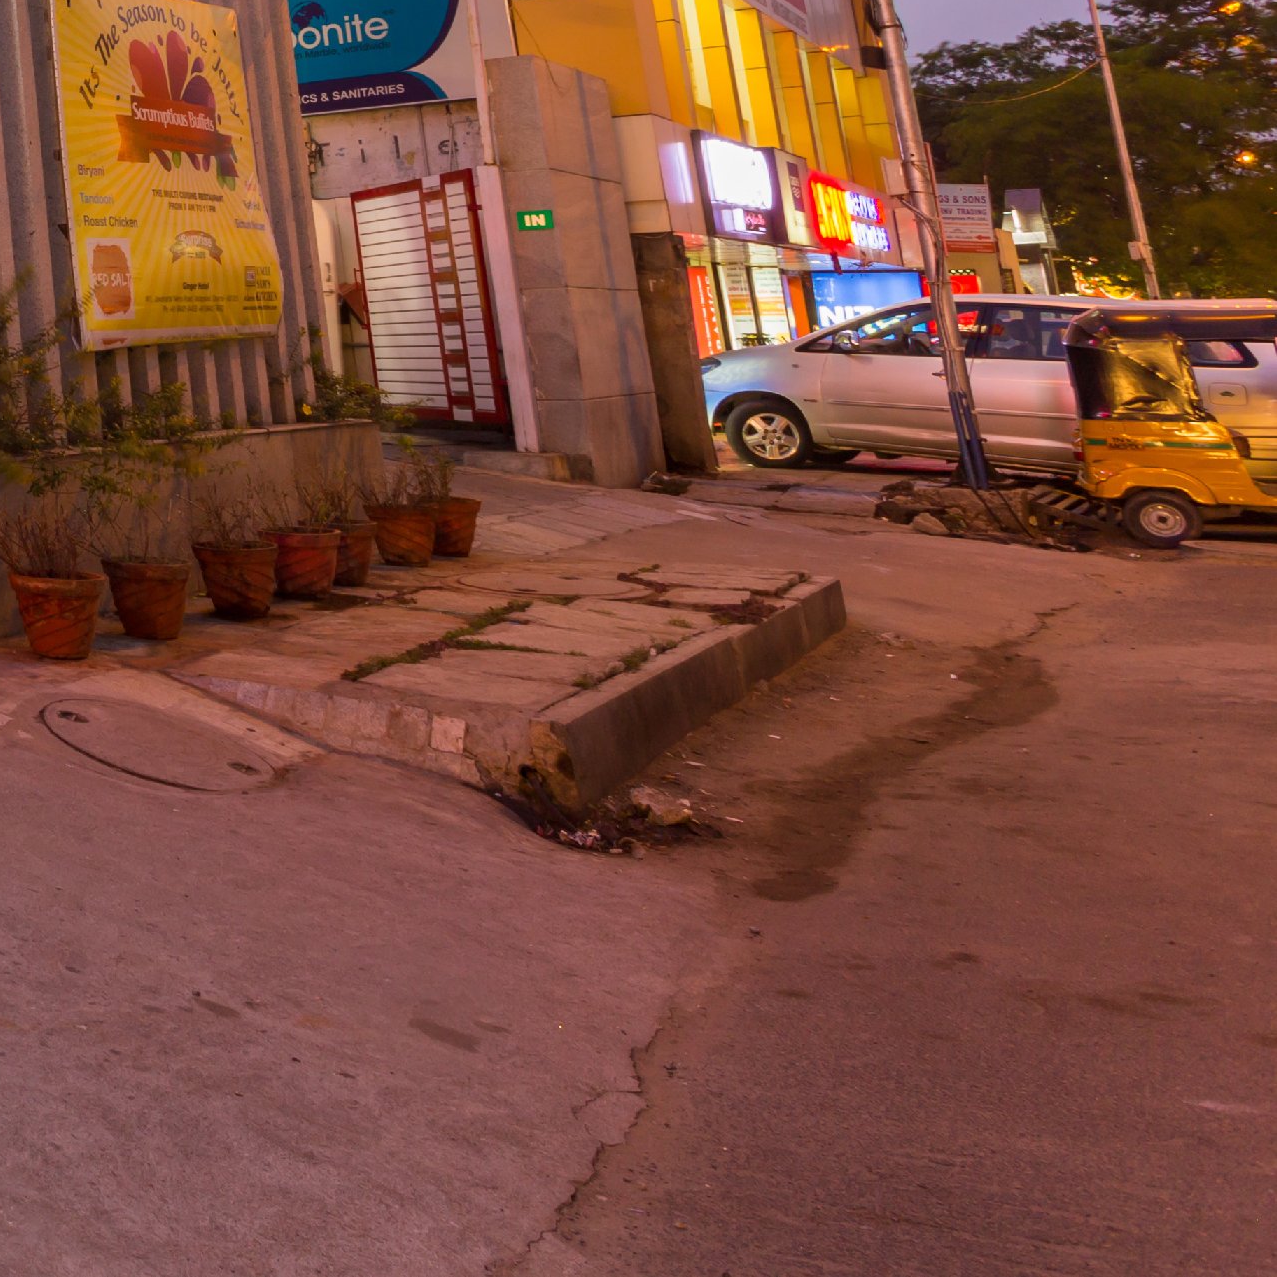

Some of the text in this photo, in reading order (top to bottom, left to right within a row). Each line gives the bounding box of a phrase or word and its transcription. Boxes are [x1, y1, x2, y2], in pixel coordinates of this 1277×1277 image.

[94, 23, 121, 67] The
[117, 3, 167, 35] Season
[170, 9, 186, 32] to
[190, 22, 208, 53] be
[320, 92, 329, 102] &
[332, 84, 405, 101] SANITARIES
[132, 101, 189, 129] Scrumptious
[77, 164, 105, 177] Biryani
[962, 195, 987, 204] SONS
[83, 214, 139, 229] Roast Chicken
[524, 214, 546, 226] IN
